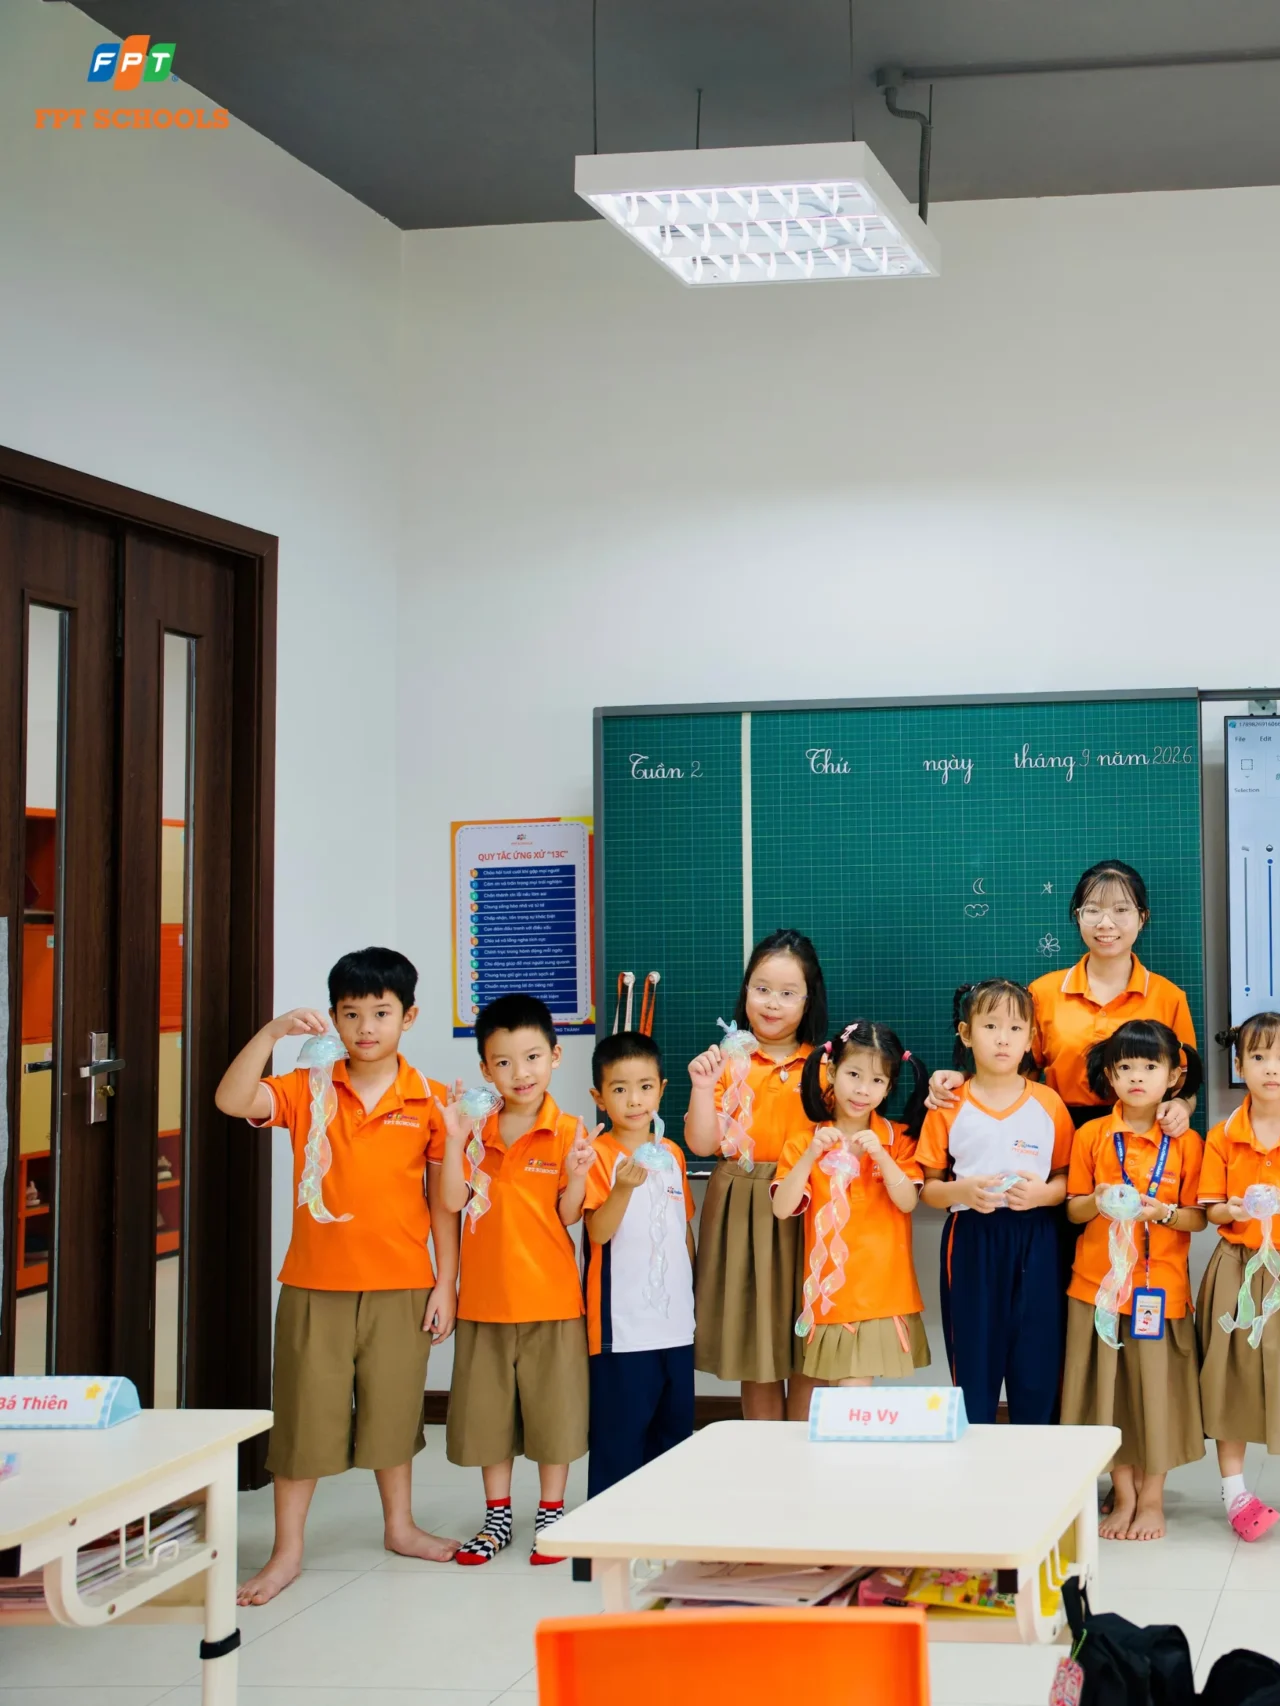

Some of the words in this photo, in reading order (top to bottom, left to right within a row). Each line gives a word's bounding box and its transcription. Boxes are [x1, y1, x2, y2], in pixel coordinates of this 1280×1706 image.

[628, 753, 685, 779] Tuần
[690, 760, 704, 778] 2
[805, 748, 851, 774] Thứ
[923, 754, 974, 785] ngày
[1013, 742, 1076, 782] tháng
[1079, 748, 1090, 767] 9
[1096, 751, 1150, 766] năm
[1152, 746, 1193, 765] 2026
[478, 853, 495, 862] QUY
[22, 1395, 69, 1410] Thiên
[848, 1408, 872, 1426] Hạ
[877, 1409, 899, 1425] Vy
